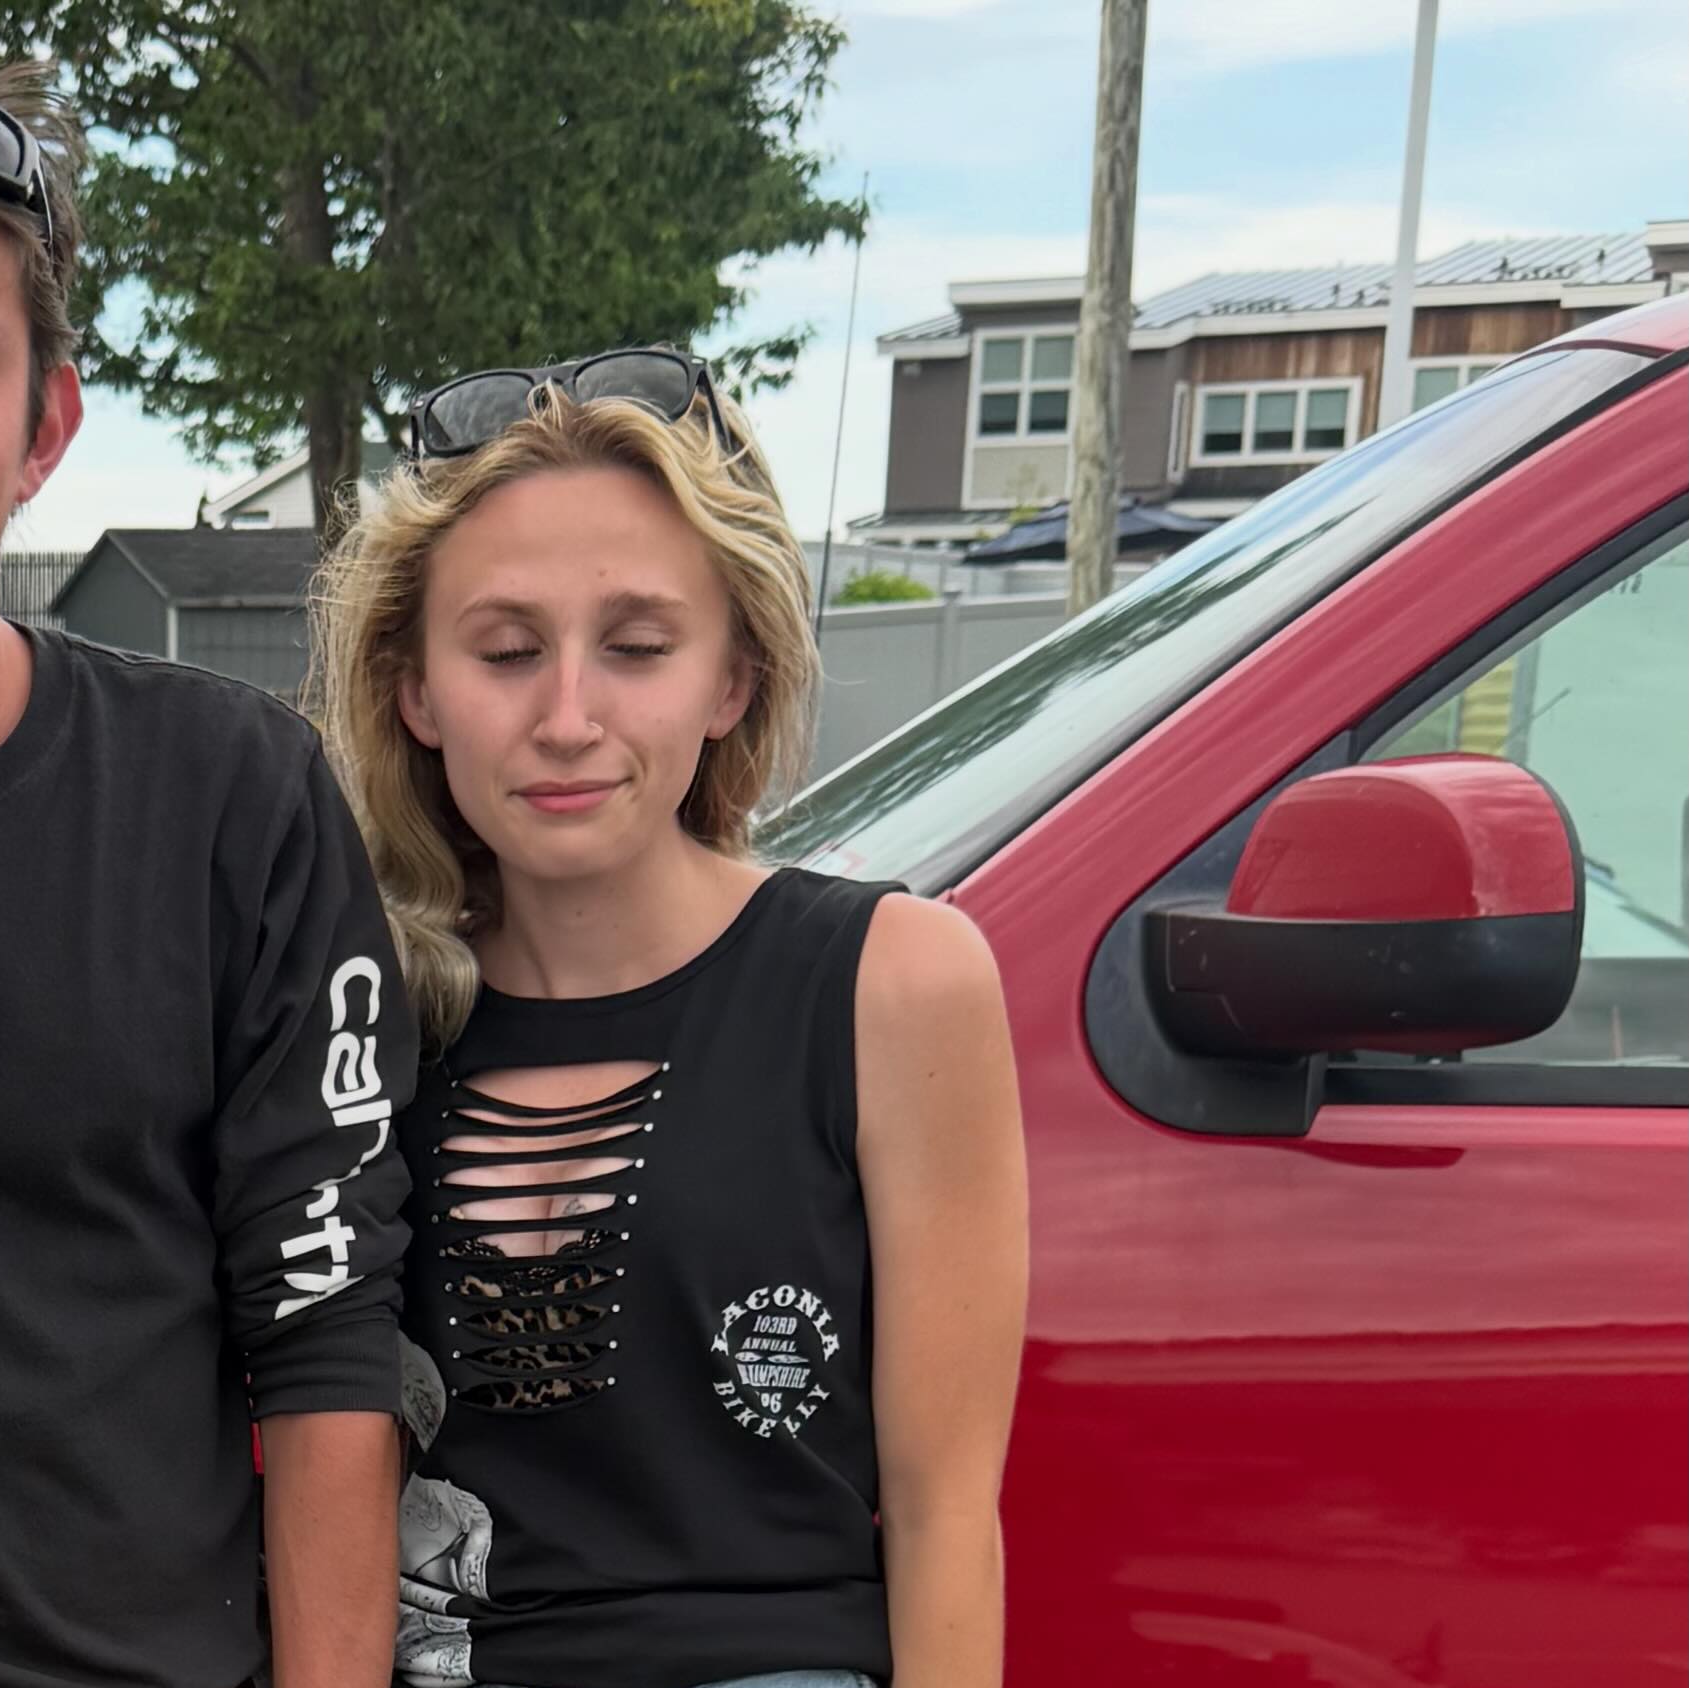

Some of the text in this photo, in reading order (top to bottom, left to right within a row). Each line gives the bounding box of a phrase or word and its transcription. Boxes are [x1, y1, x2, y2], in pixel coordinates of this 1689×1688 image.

[711, 1285, 840, 1362] LACONIA
[752, 1315, 798, 1335] 103RD
[741, 1337, 797, 1353] ANNUAL
[713, 1380, 778, 1438] BIKE
